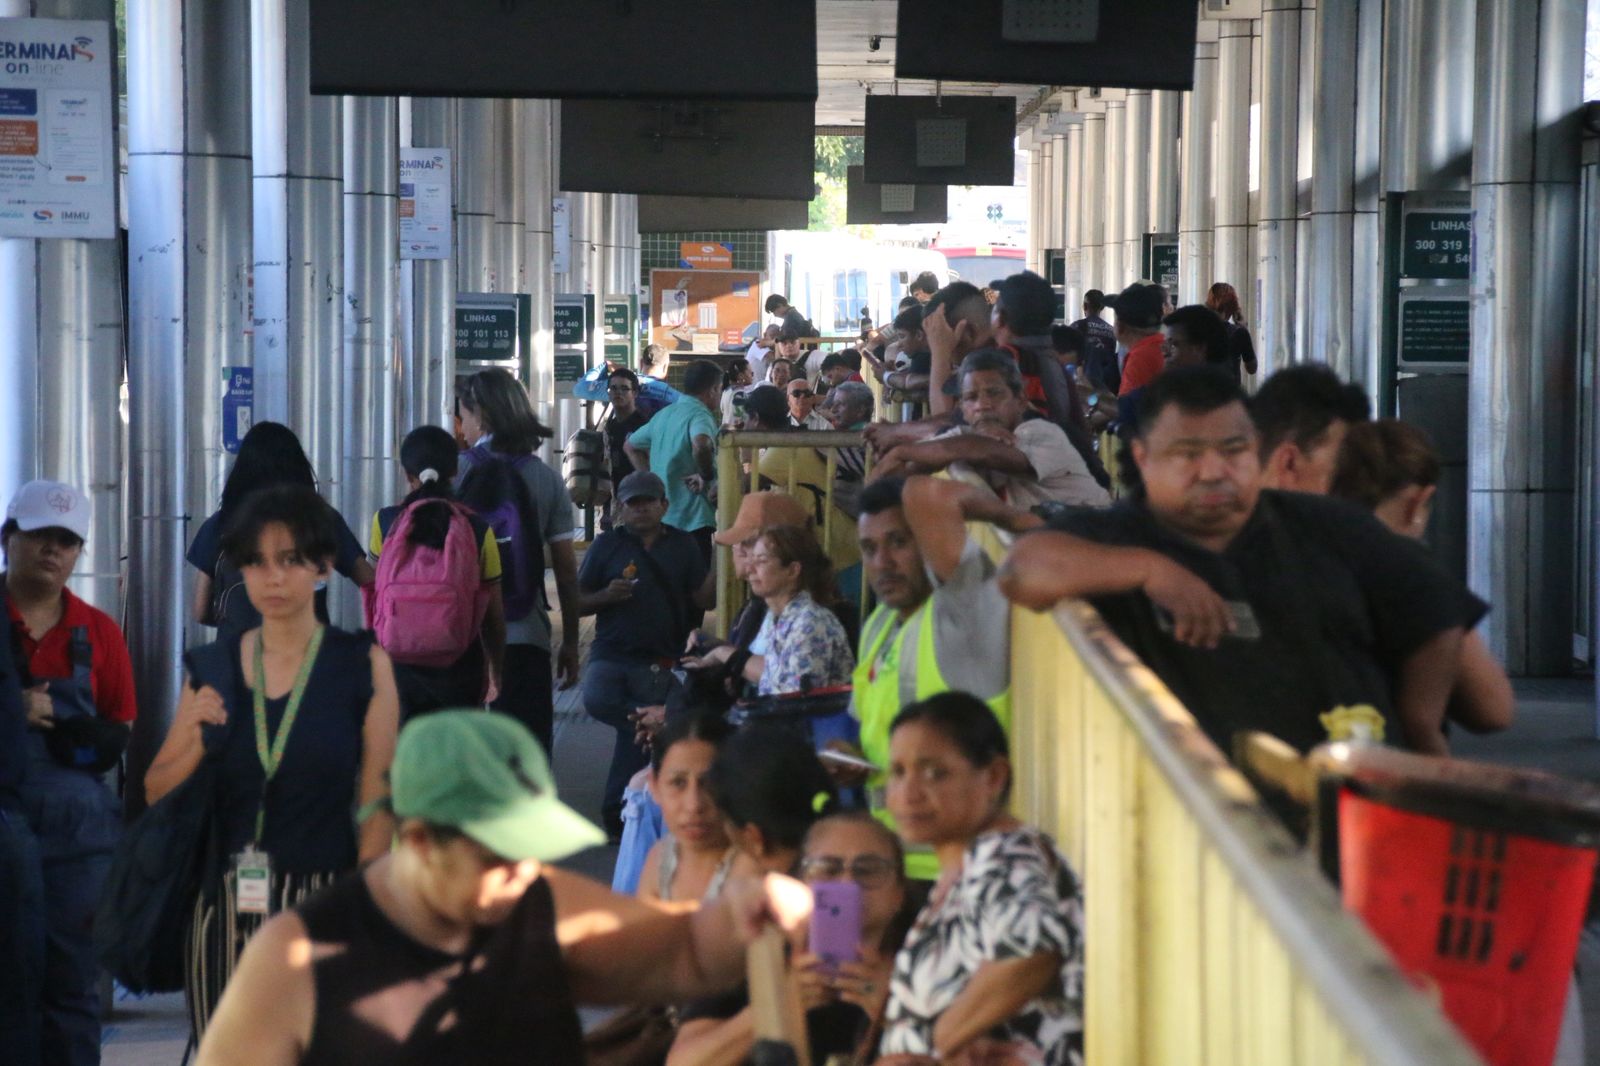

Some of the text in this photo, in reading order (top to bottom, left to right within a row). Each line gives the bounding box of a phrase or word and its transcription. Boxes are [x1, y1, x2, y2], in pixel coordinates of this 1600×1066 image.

[61, 211, 90, 220] IMMU
[1431, 220, 1472, 230] LINHAS
[1415, 239, 1462, 250] 300 319
[463, 314, 497, 323] LINHAS
[473, 329, 488, 338] 101
[494, 330, 509, 338] 113
